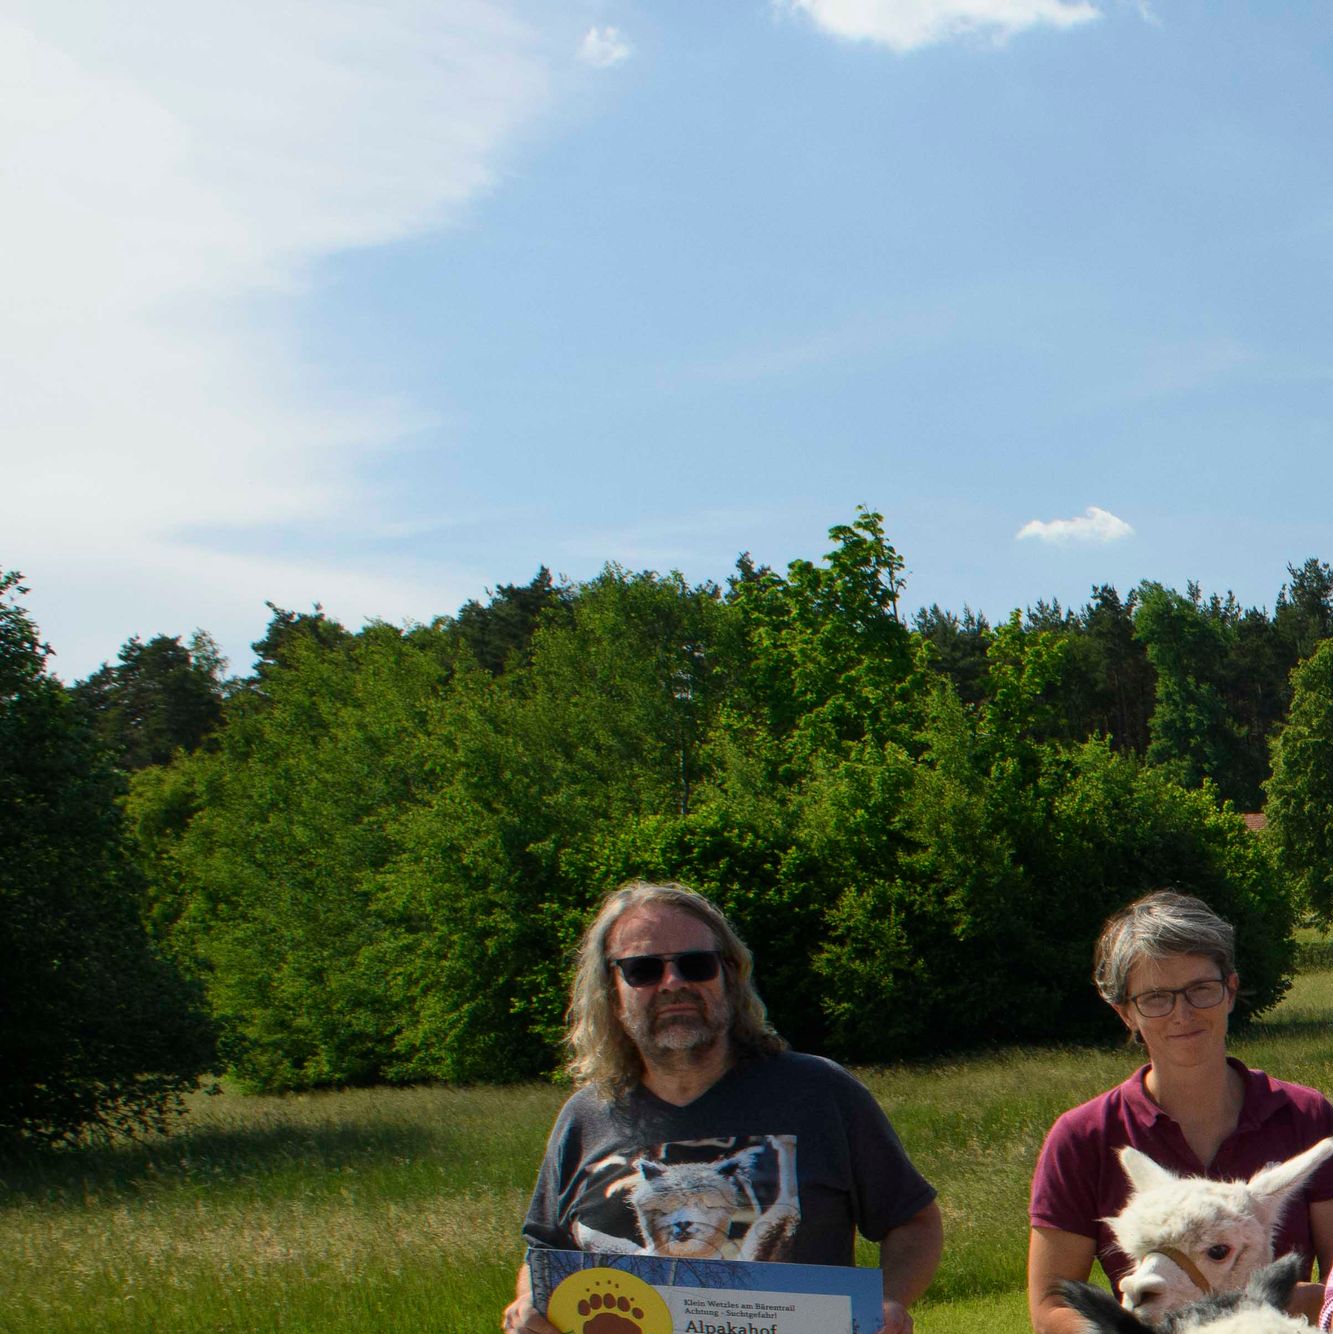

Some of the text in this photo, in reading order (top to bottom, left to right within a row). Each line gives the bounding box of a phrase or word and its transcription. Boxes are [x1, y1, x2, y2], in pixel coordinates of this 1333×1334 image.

[706, 1300, 739, 1310] Wetzles
[754, 1303, 795, 1311] Bärentrail
[684, 1308, 719, 1318] Achtung
